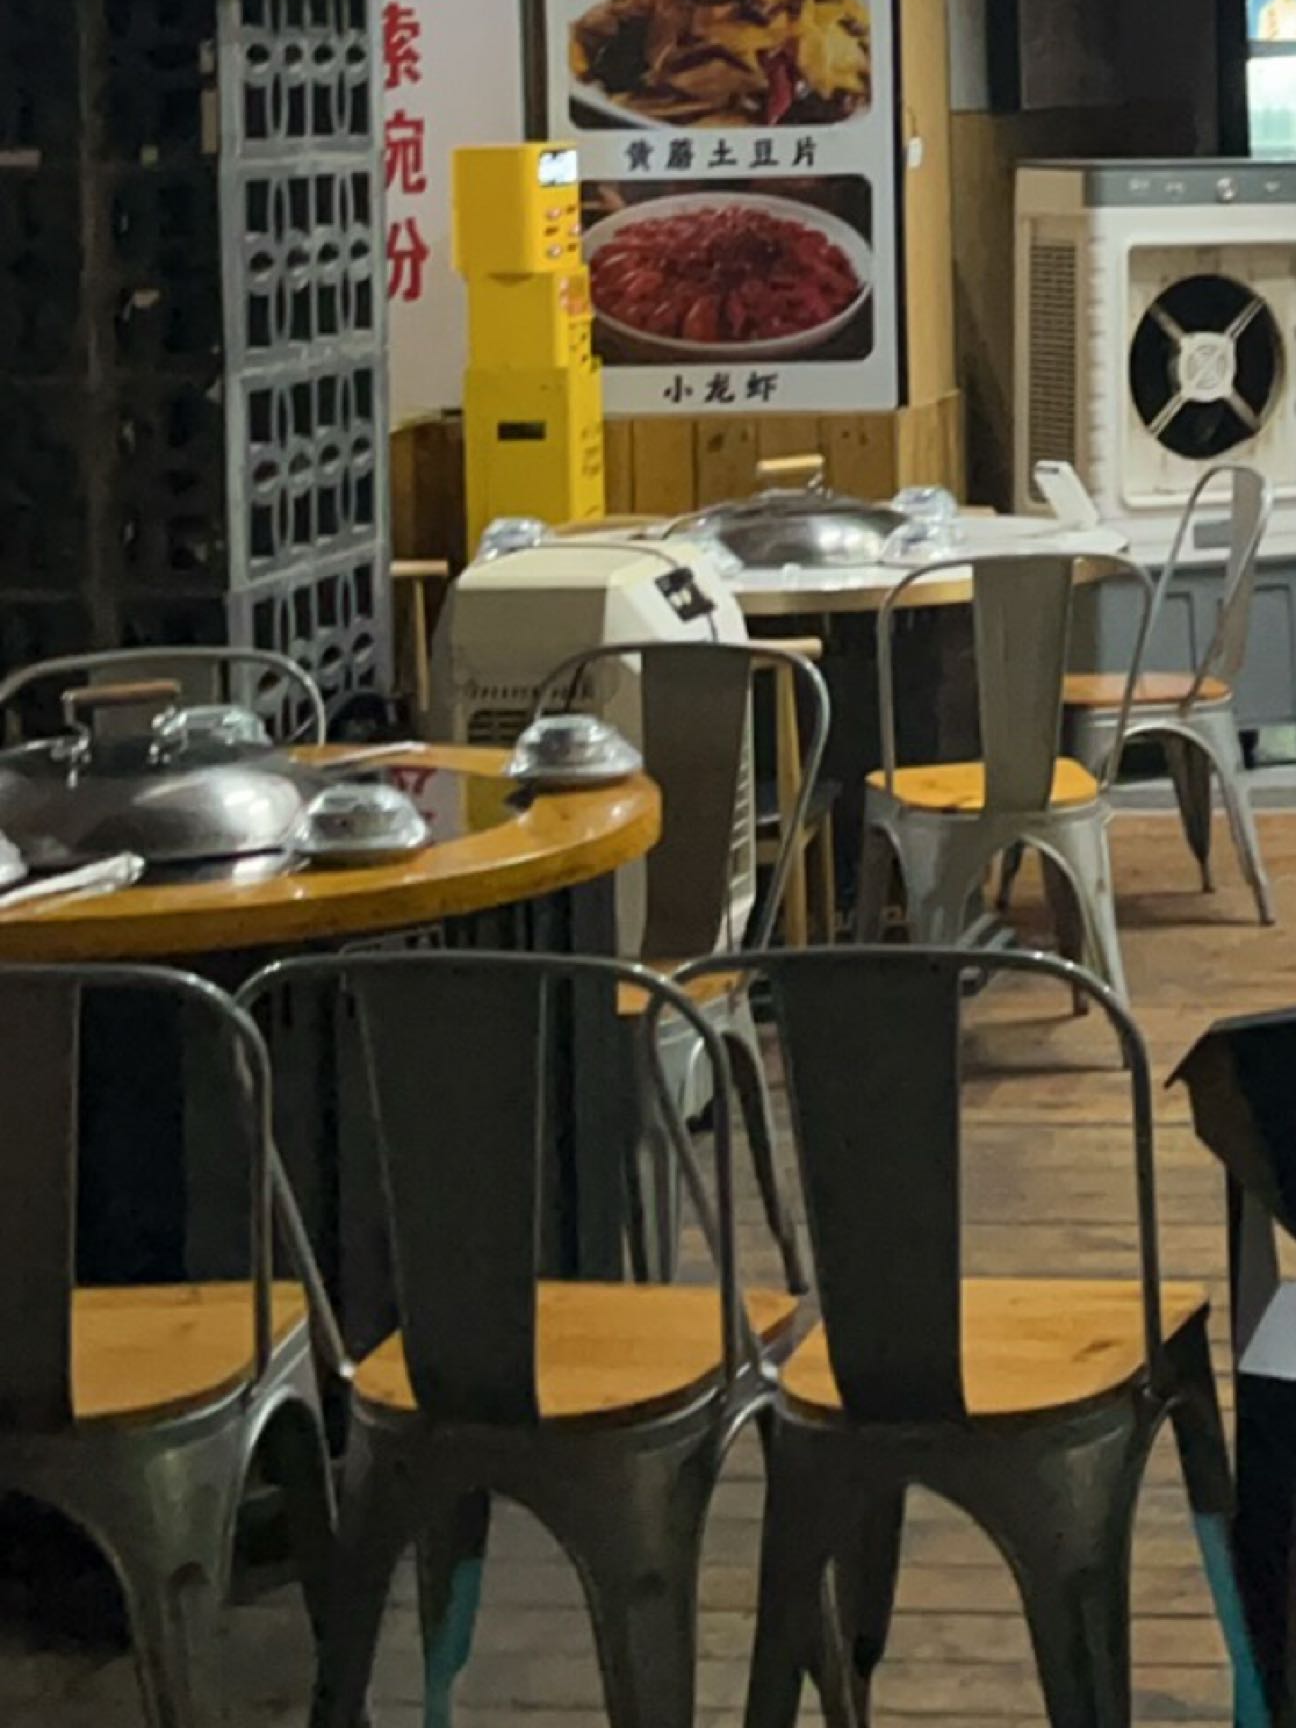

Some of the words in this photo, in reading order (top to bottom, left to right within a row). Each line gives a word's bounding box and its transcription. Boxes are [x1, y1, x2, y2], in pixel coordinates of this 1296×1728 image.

[624, 135, 818, 171] 黄蘑土豆片
[663, 372, 779, 404] 小龙虾
